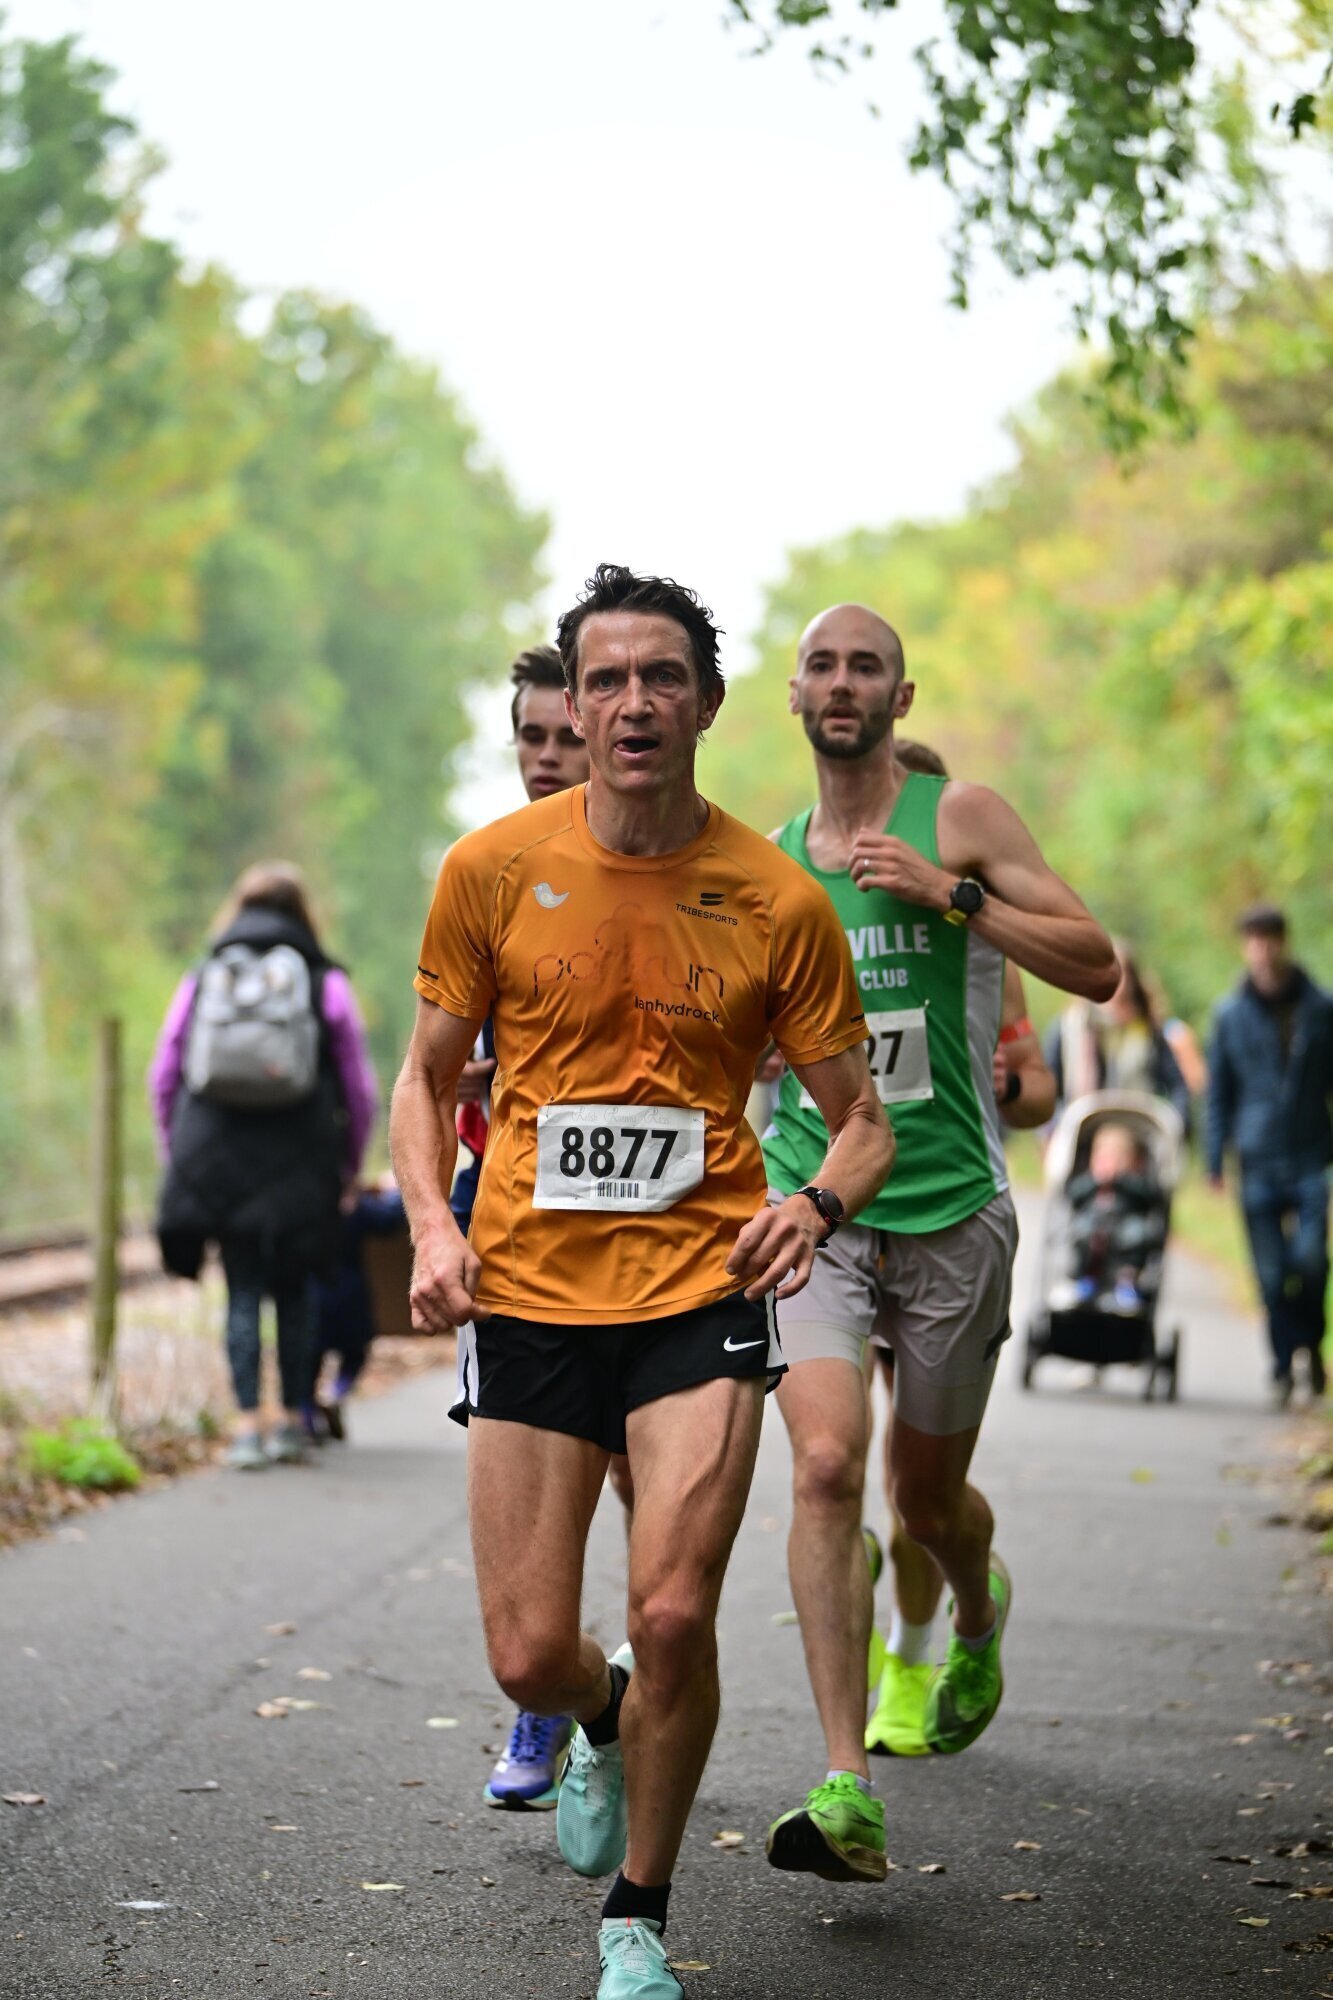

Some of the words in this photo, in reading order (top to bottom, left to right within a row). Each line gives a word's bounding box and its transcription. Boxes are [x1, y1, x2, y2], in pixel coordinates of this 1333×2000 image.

[675, 903, 738, 926] TRIBESPORTS
[846, 923, 931, 962] VILLE
[859, 967, 909, 991] CLUB
[559, 1126, 679, 1180] 8877
